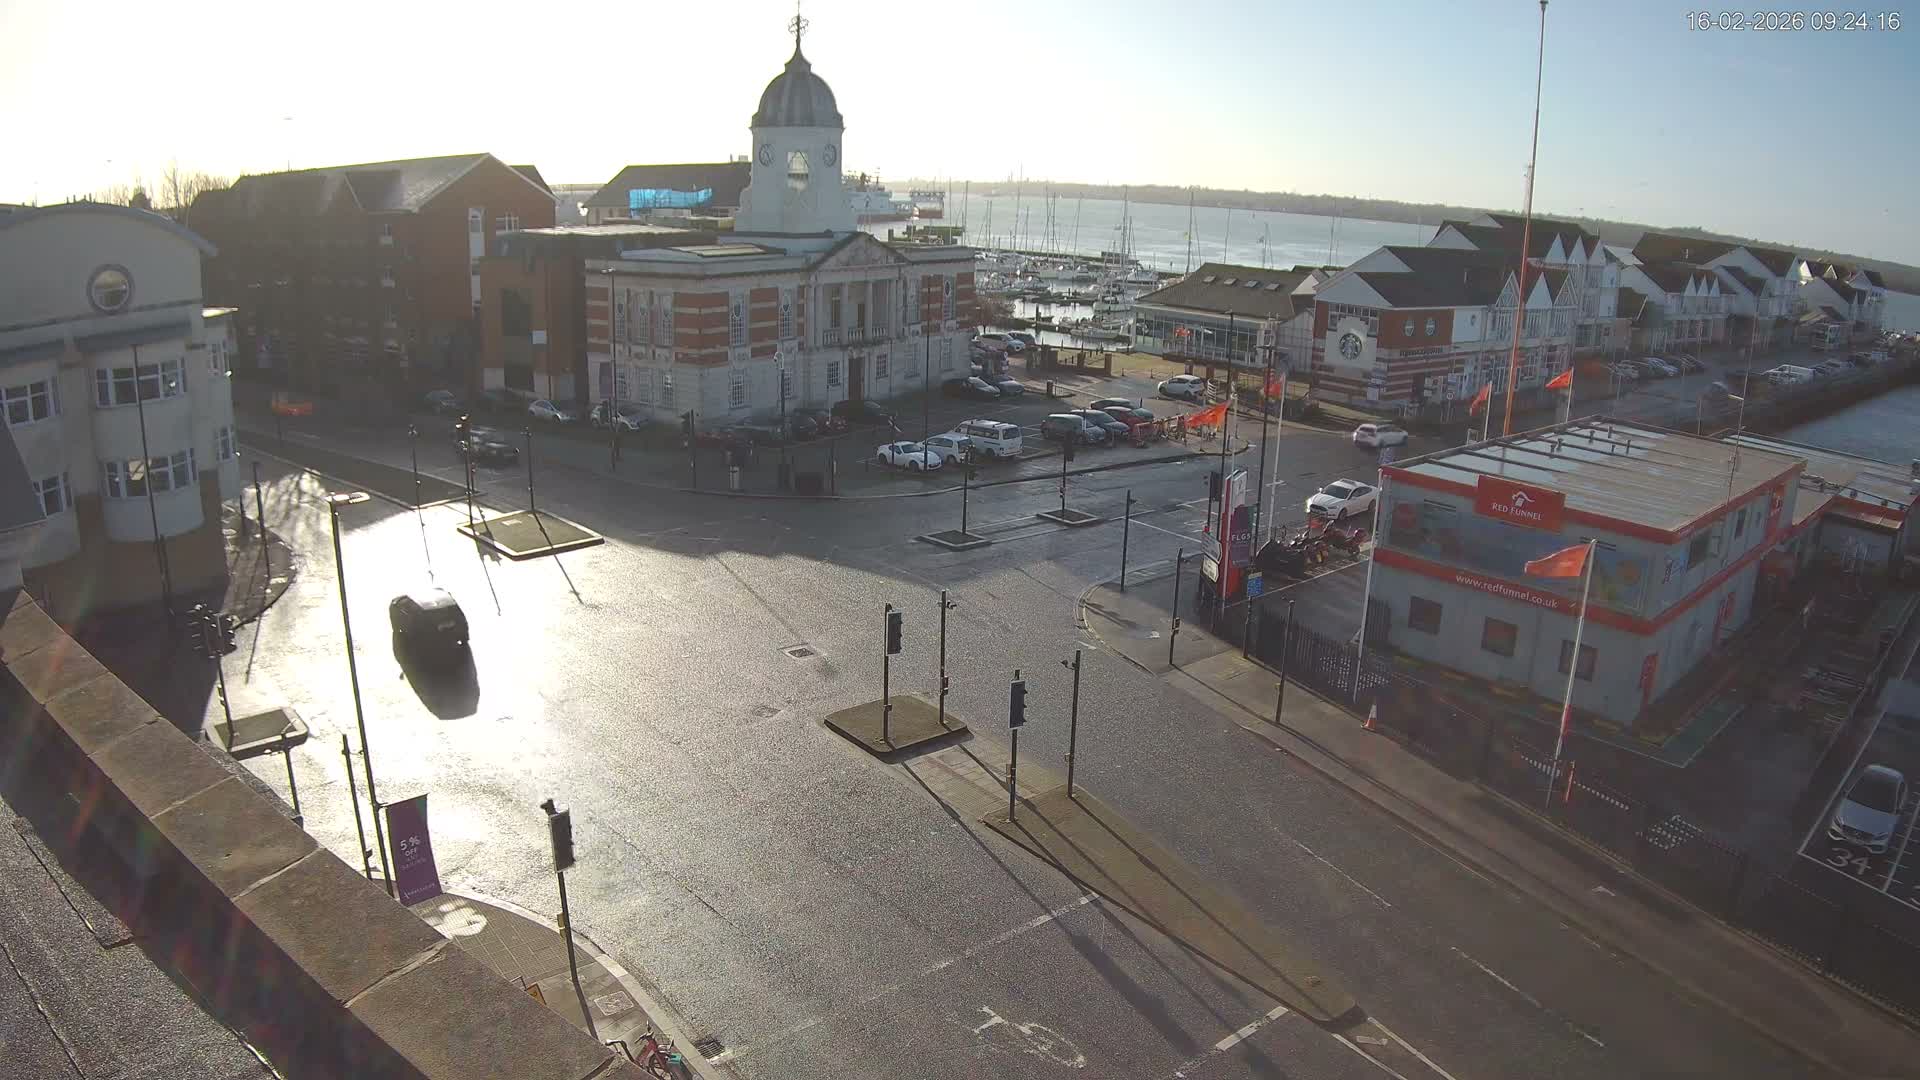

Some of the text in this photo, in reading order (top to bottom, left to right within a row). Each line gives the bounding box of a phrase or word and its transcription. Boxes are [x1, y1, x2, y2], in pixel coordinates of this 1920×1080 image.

[1492, 502, 1542, 520] RED FUNNEL
[1456, 574, 1558, 608] www.redfunnel.co.uk
[1826, 847, 1872, 875] 34
